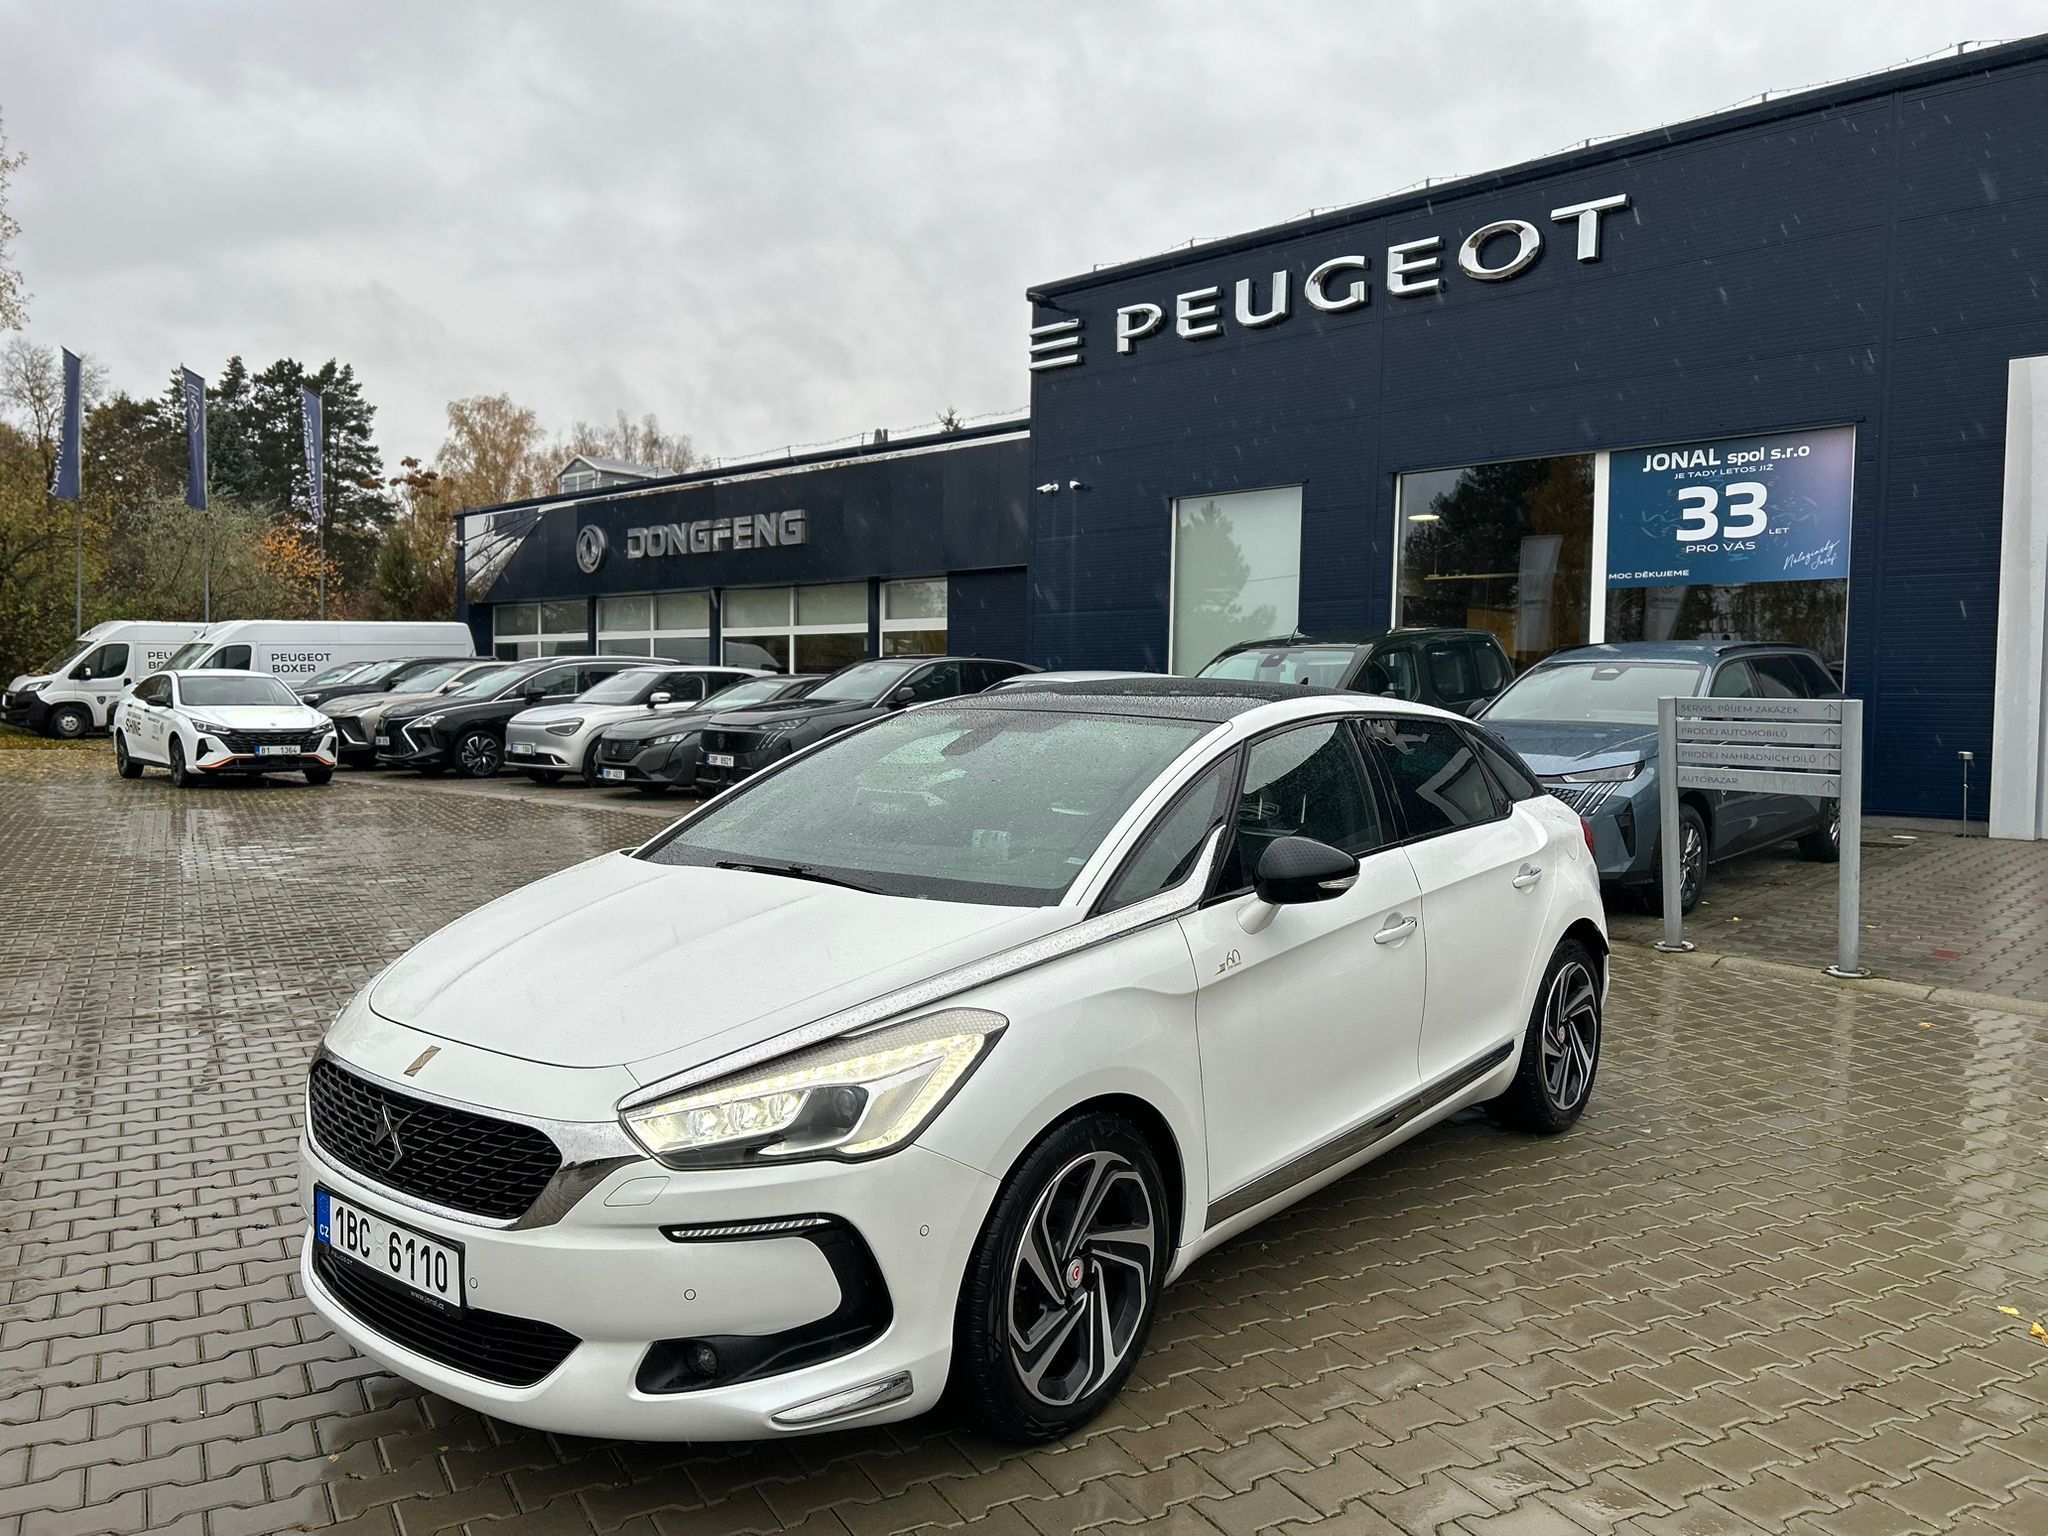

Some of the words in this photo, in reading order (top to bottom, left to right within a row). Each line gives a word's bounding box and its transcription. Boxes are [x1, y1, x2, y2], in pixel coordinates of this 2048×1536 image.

[1116, 193, 1631, 355] PEUGEOT
[1643, 448, 1721, 472] JONAL
[1727, 446, 1765, 466] spol
[1770, 445, 1811, 460] s.r.o
[1674, 472, 1685, 480] JE
[1687, 469, 1718, 478] TADY
[1720, 465, 1757, 475] LETOS
[1758, 463, 1774, 472] JIŽ
[1676, 481, 1768, 542] 33
[627, 509, 808, 559] DONGFENG
[1769, 527, 1790, 535] LET
[1686, 543, 1719, 554] PRO
[1723, 541, 1756, 551] VÁS
[1608, 572, 1633, 580] MOC
[1634, 569, 1690, 579] DĚKUJEME
[271, 653, 332, 662] PEUGEOT
[272, 664, 317, 673] BOXER
[1681, 704, 1716, 713] SERVIS,
[1718, 703, 1753, 714] PŘÍJEM
[1755, 704, 1799, 714] ZAKÁZEK
[1681, 727, 1718, 736] PRODEJ
[1720, 727, 1788, 738] AUTOMOBILŮ
[1681, 751, 1718, 760] PRODEJ
[1793, 754, 1816, 764] DÍLŮ
[1681, 775, 1738, 784] AUTOBAZAR
[319, 1224, 330, 1238] CZ
[335, 1206, 371, 1258] 1BC
[389, 1231, 447, 1293] 6110
